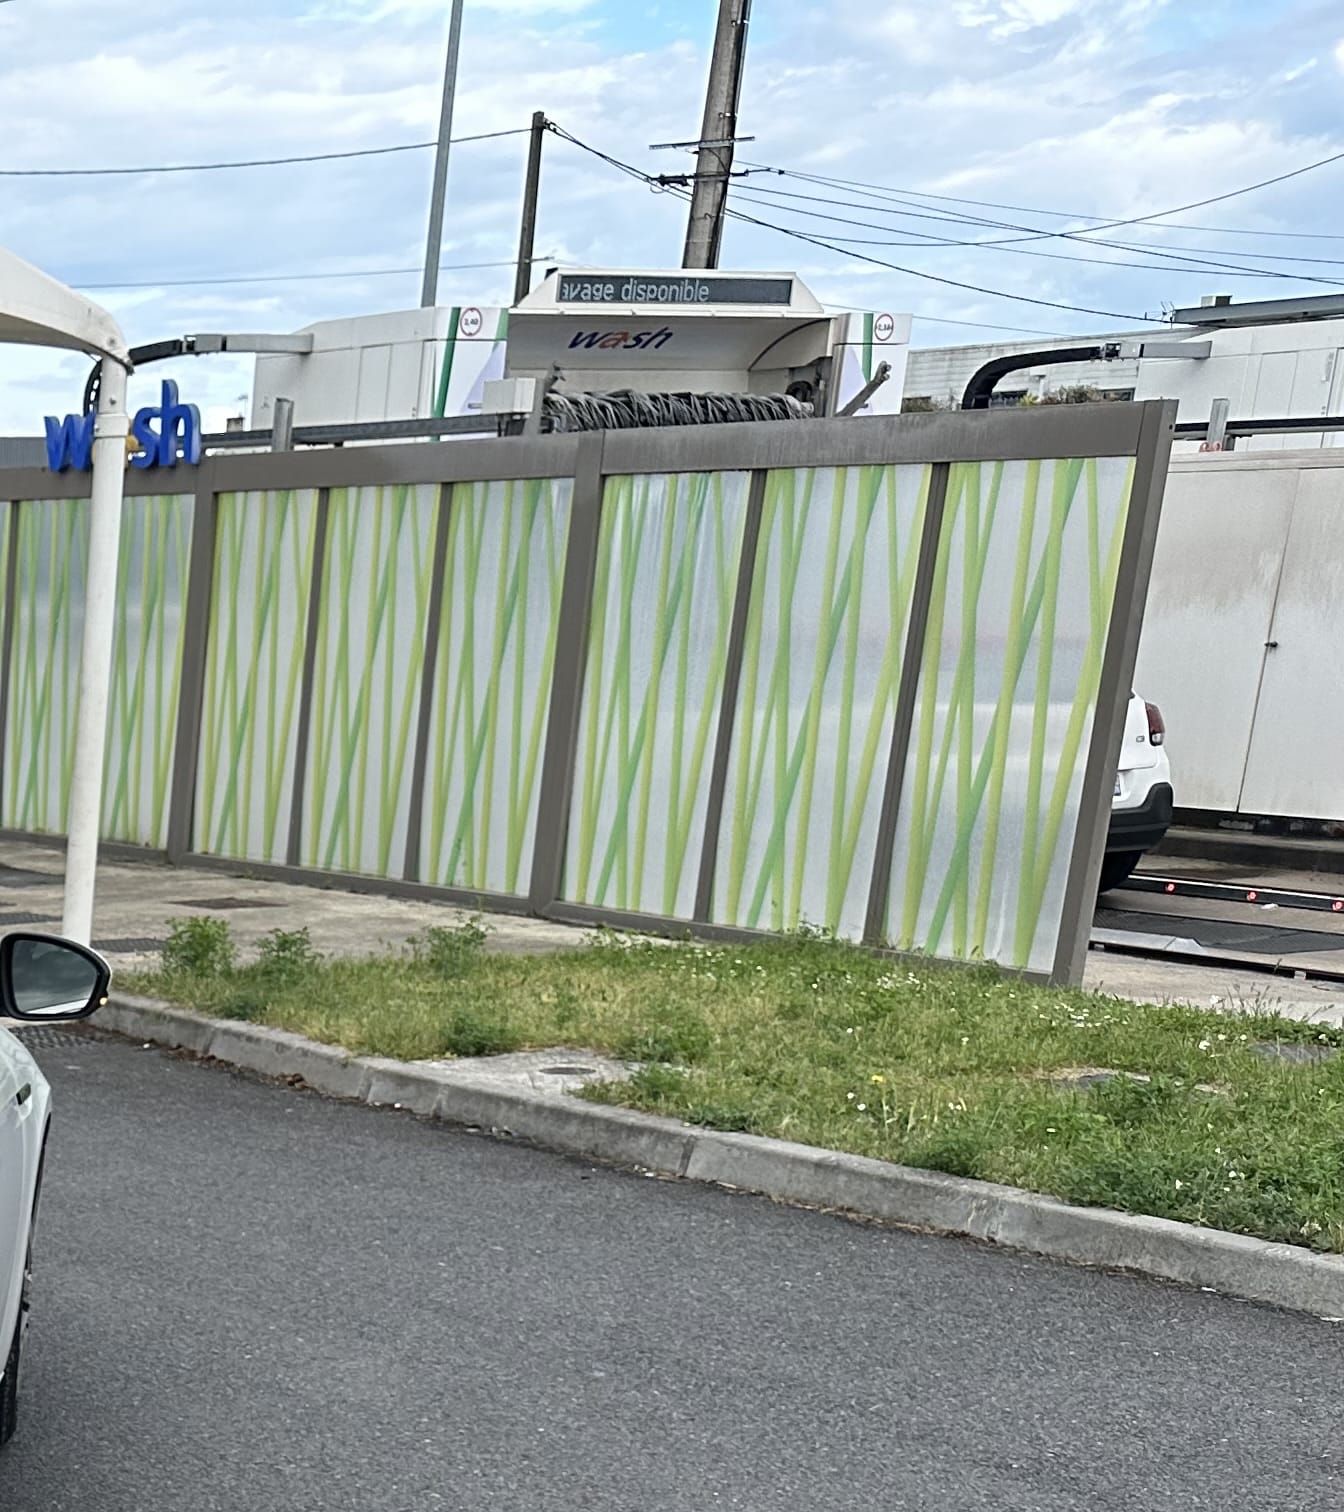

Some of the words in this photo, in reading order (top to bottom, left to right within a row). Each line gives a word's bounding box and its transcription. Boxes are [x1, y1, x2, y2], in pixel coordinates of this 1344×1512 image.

[620, 277, 710, 302] disponible
[568, 326, 674, 349] wash
[44, 378, 202, 472] wsh
